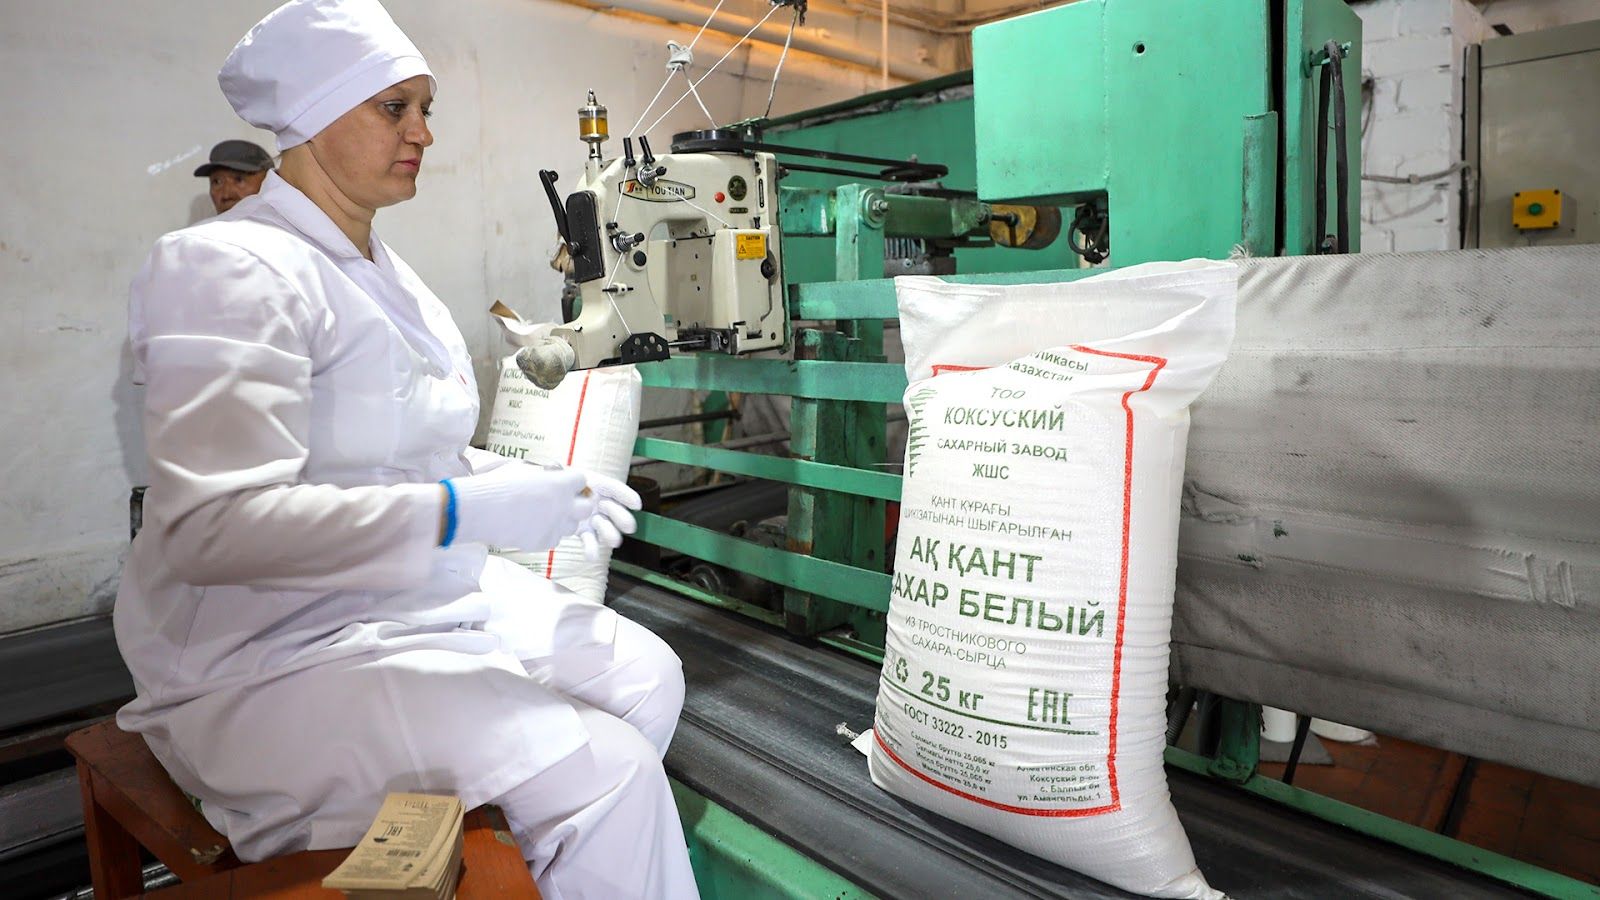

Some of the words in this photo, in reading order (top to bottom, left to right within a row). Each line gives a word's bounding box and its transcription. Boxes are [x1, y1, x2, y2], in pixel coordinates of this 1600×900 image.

[651, 185, 666, 195] YOU
[1032, 351, 1089, 372] ликасы
[991, 387, 1026, 399] ТОО
[944, 405, 1065, 431] КОКСУСКИЙ
[937, 438, 1006, 453] САХАРНЫЙ
[1011, 443, 1067, 462] ЗАВОД
[972, 463, 1010, 480] ЖШС
[967, 517, 1072, 542] ШЫҒАРЫЛҒАН
[910, 535, 941, 571] АҚ
[948, 542, 1042, 582] ҚАНТ
[893, 572, 949, 608] АХАР
[959, 588, 1105, 637] БЕЛЫЙ
[905, 615, 916, 628] ИЗ
[918, 620, 1027, 655] ТРОСТНИКОВОГО
[911, 634, 1007, 670] САХАРА-СЫРЦА
[921, 671, 951, 701] 25
[958, 690, 984, 711] кг
[904, 703, 929, 726] ГОСТ
[932, 716, 964, 740] 33222
[976, 730, 1008, 749] 2015
[939, 741, 962, 757] брутто
[1029, 774, 1077, 783] Коксуский
